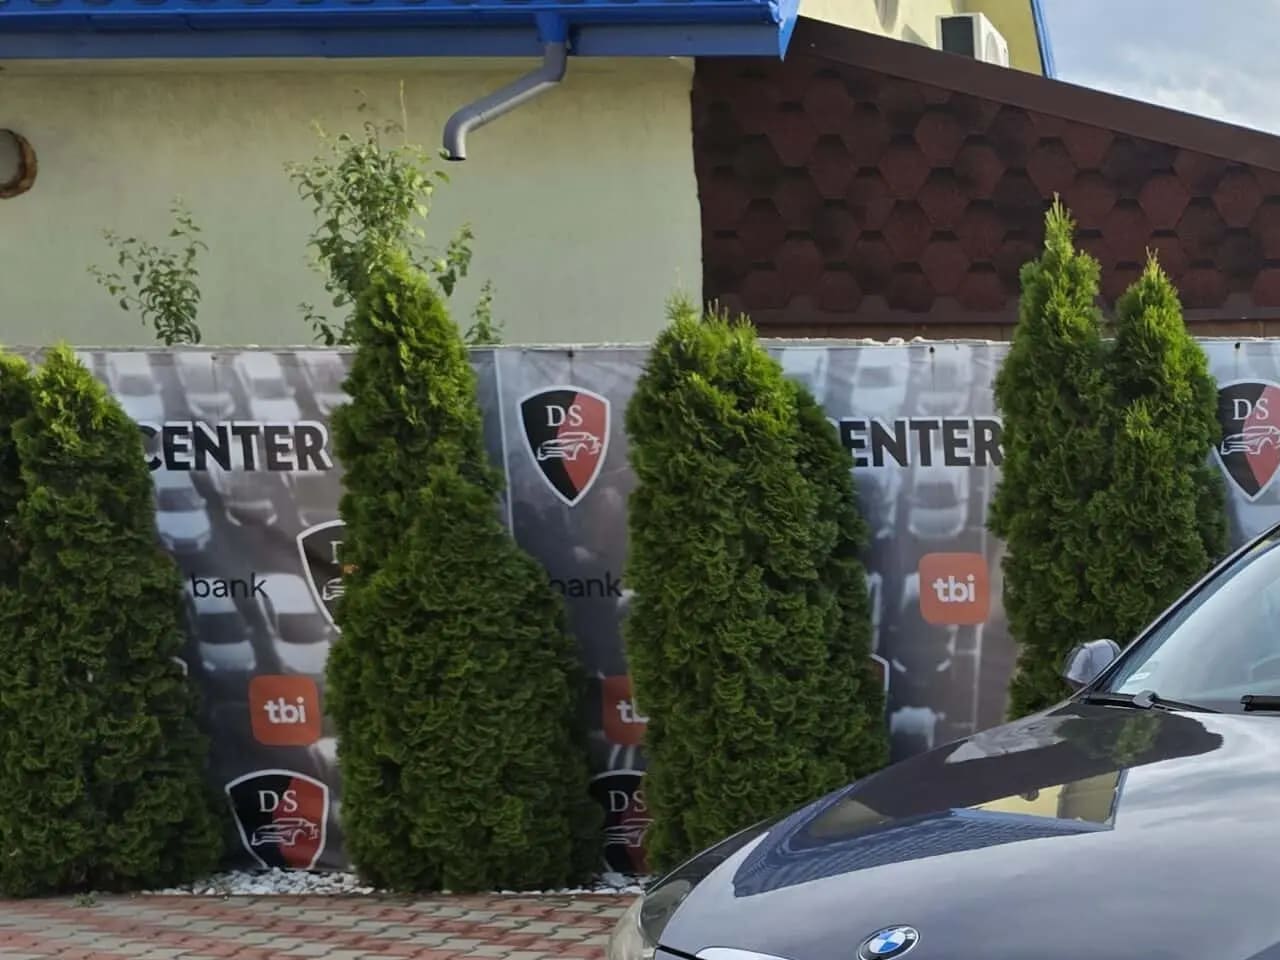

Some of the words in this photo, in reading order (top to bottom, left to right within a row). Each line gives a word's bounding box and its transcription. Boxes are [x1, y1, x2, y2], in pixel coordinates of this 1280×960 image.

[545, 404, 583, 427] DS
[1232, 398, 1270, 421] DS
[840, 419, 1004, 467] ENTER
[191, 572, 270, 599] bank
[932, 573, 976, 603] tbi
[264, 696, 307, 724] tbi
[258, 790, 299, 812] DS
[608, 790, 648, 812] DS
